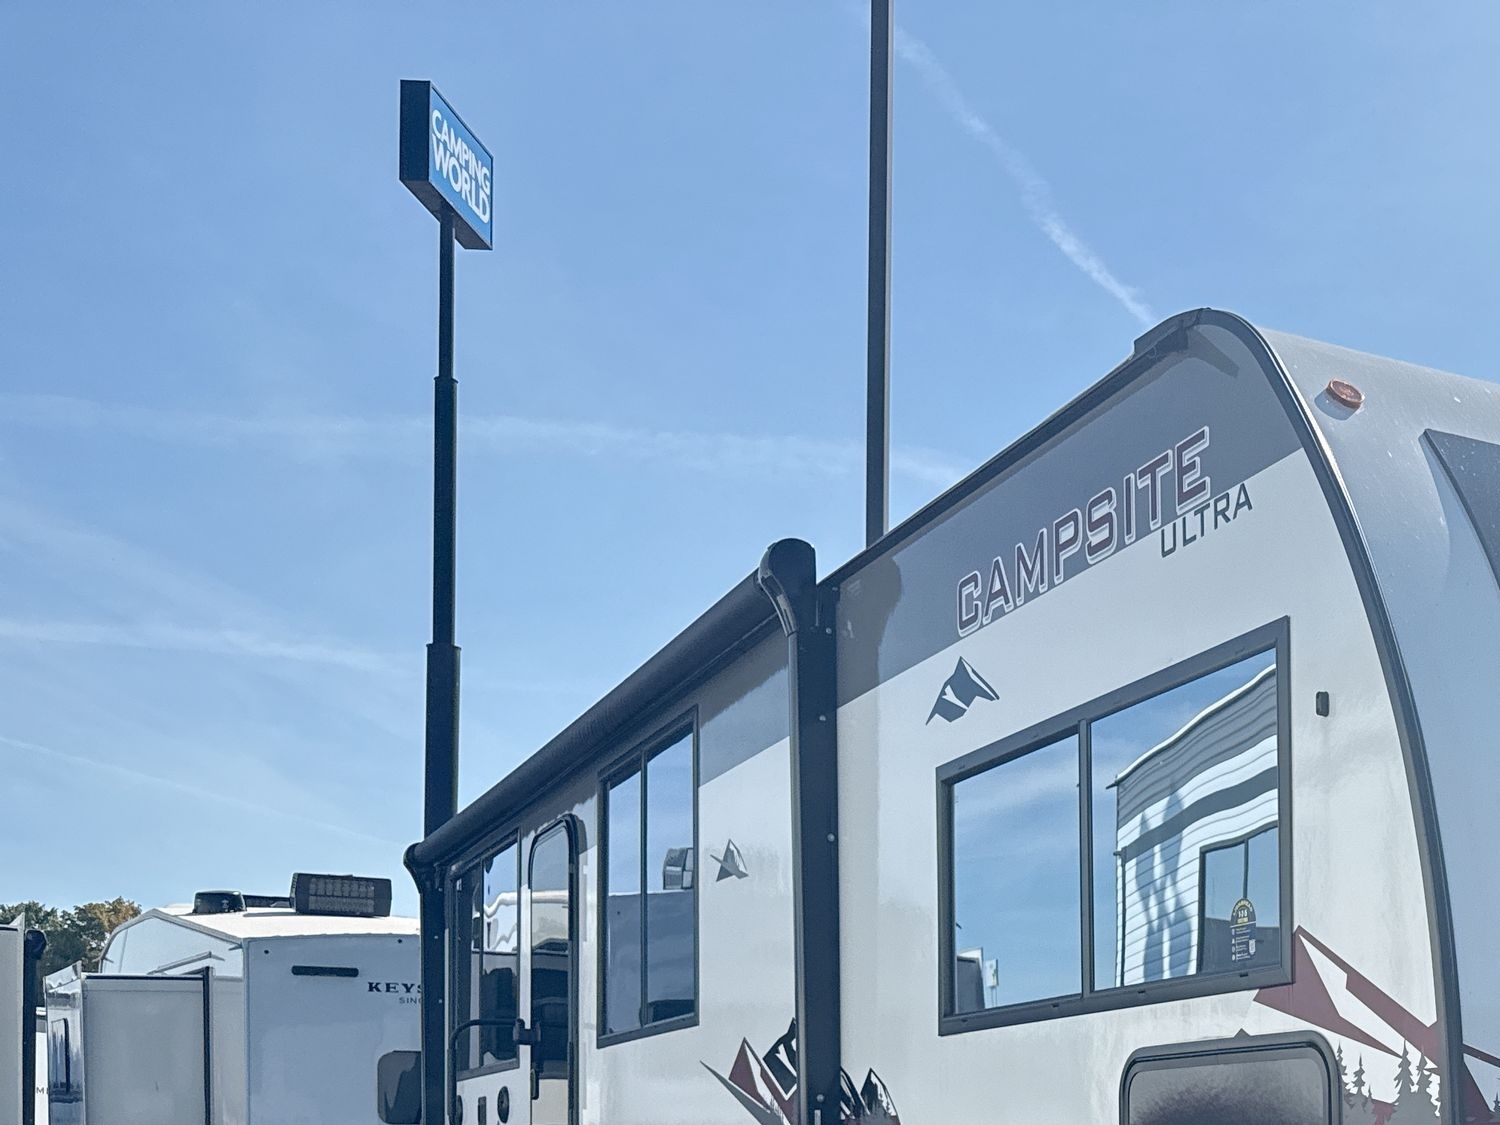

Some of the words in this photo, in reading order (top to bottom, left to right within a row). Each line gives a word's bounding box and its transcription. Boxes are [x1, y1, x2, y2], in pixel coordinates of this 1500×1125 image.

[431, 109, 490, 196] CAMPING
[431, 133, 490, 224] WORLD
[957, 425, 1211, 637] CAMPSITE
[1160, 482, 1253, 558] ULTRA
